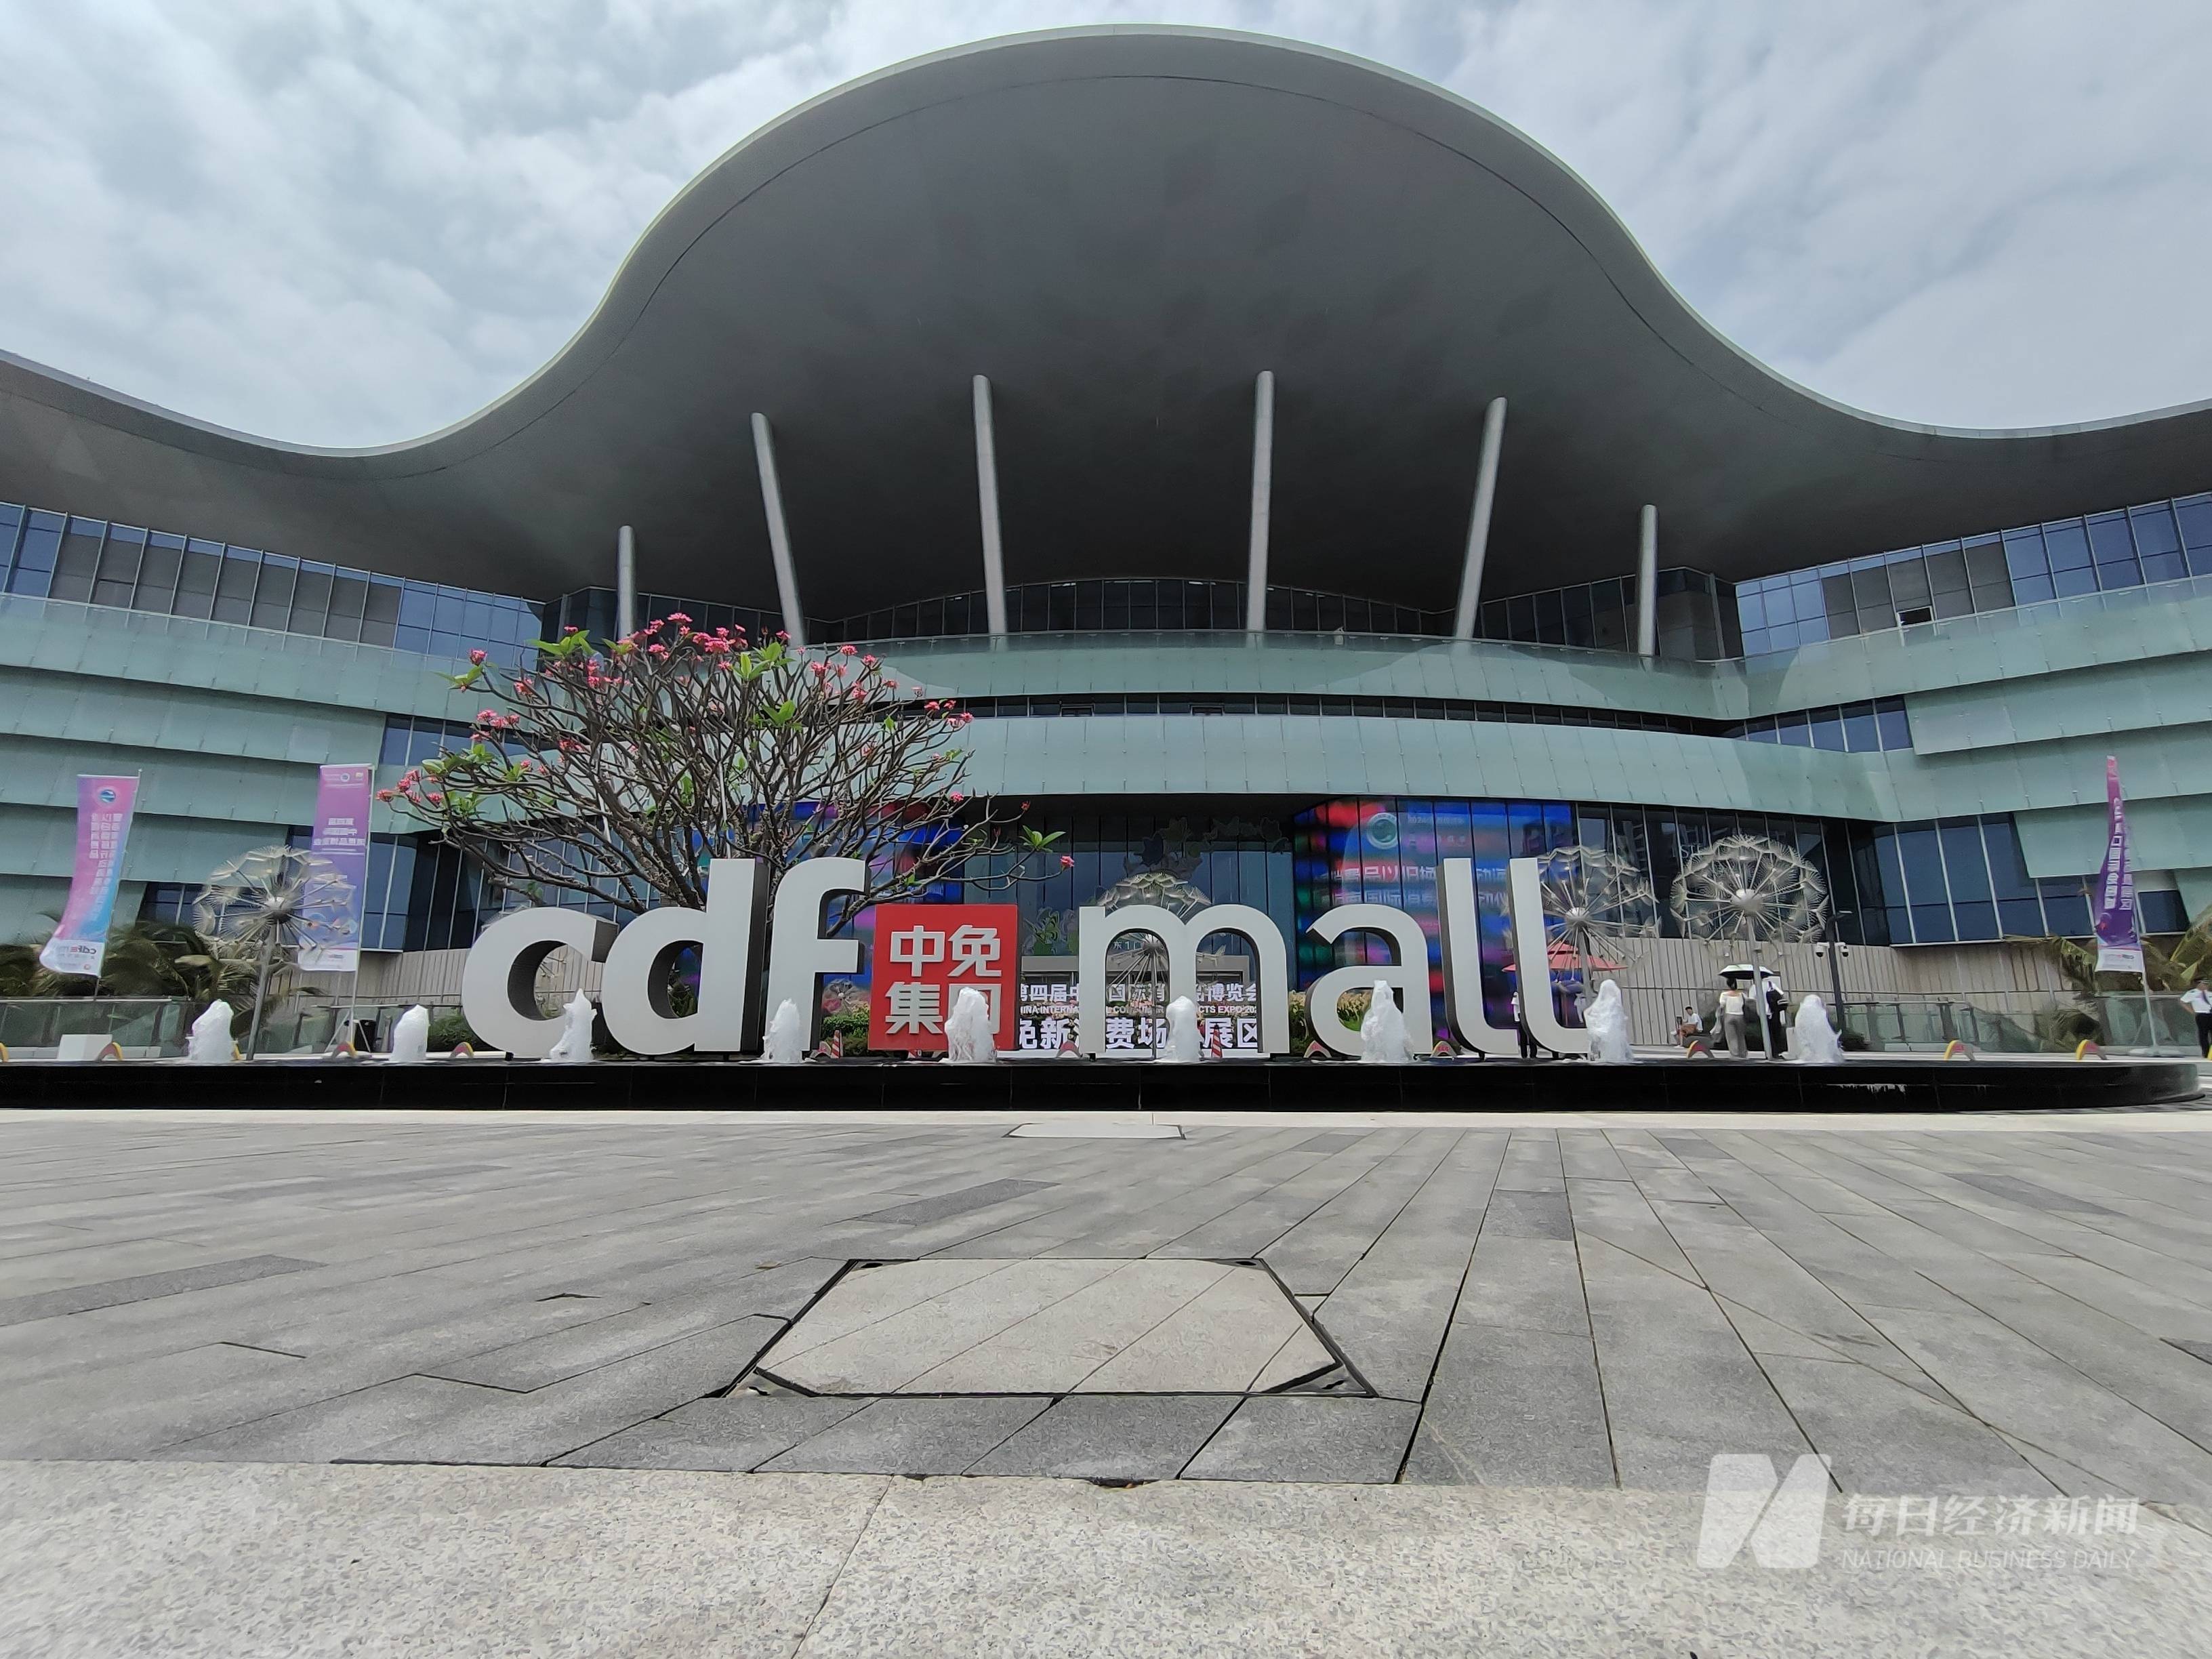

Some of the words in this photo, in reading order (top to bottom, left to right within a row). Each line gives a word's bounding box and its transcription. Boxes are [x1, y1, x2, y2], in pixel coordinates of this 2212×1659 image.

[463, 857, 868, 1055] cdf
[1079, 857, 1591, 1056] mall
[890, 924, 1002, 977] 中免
[1218, 1005, 1242, 1014] EXPO
